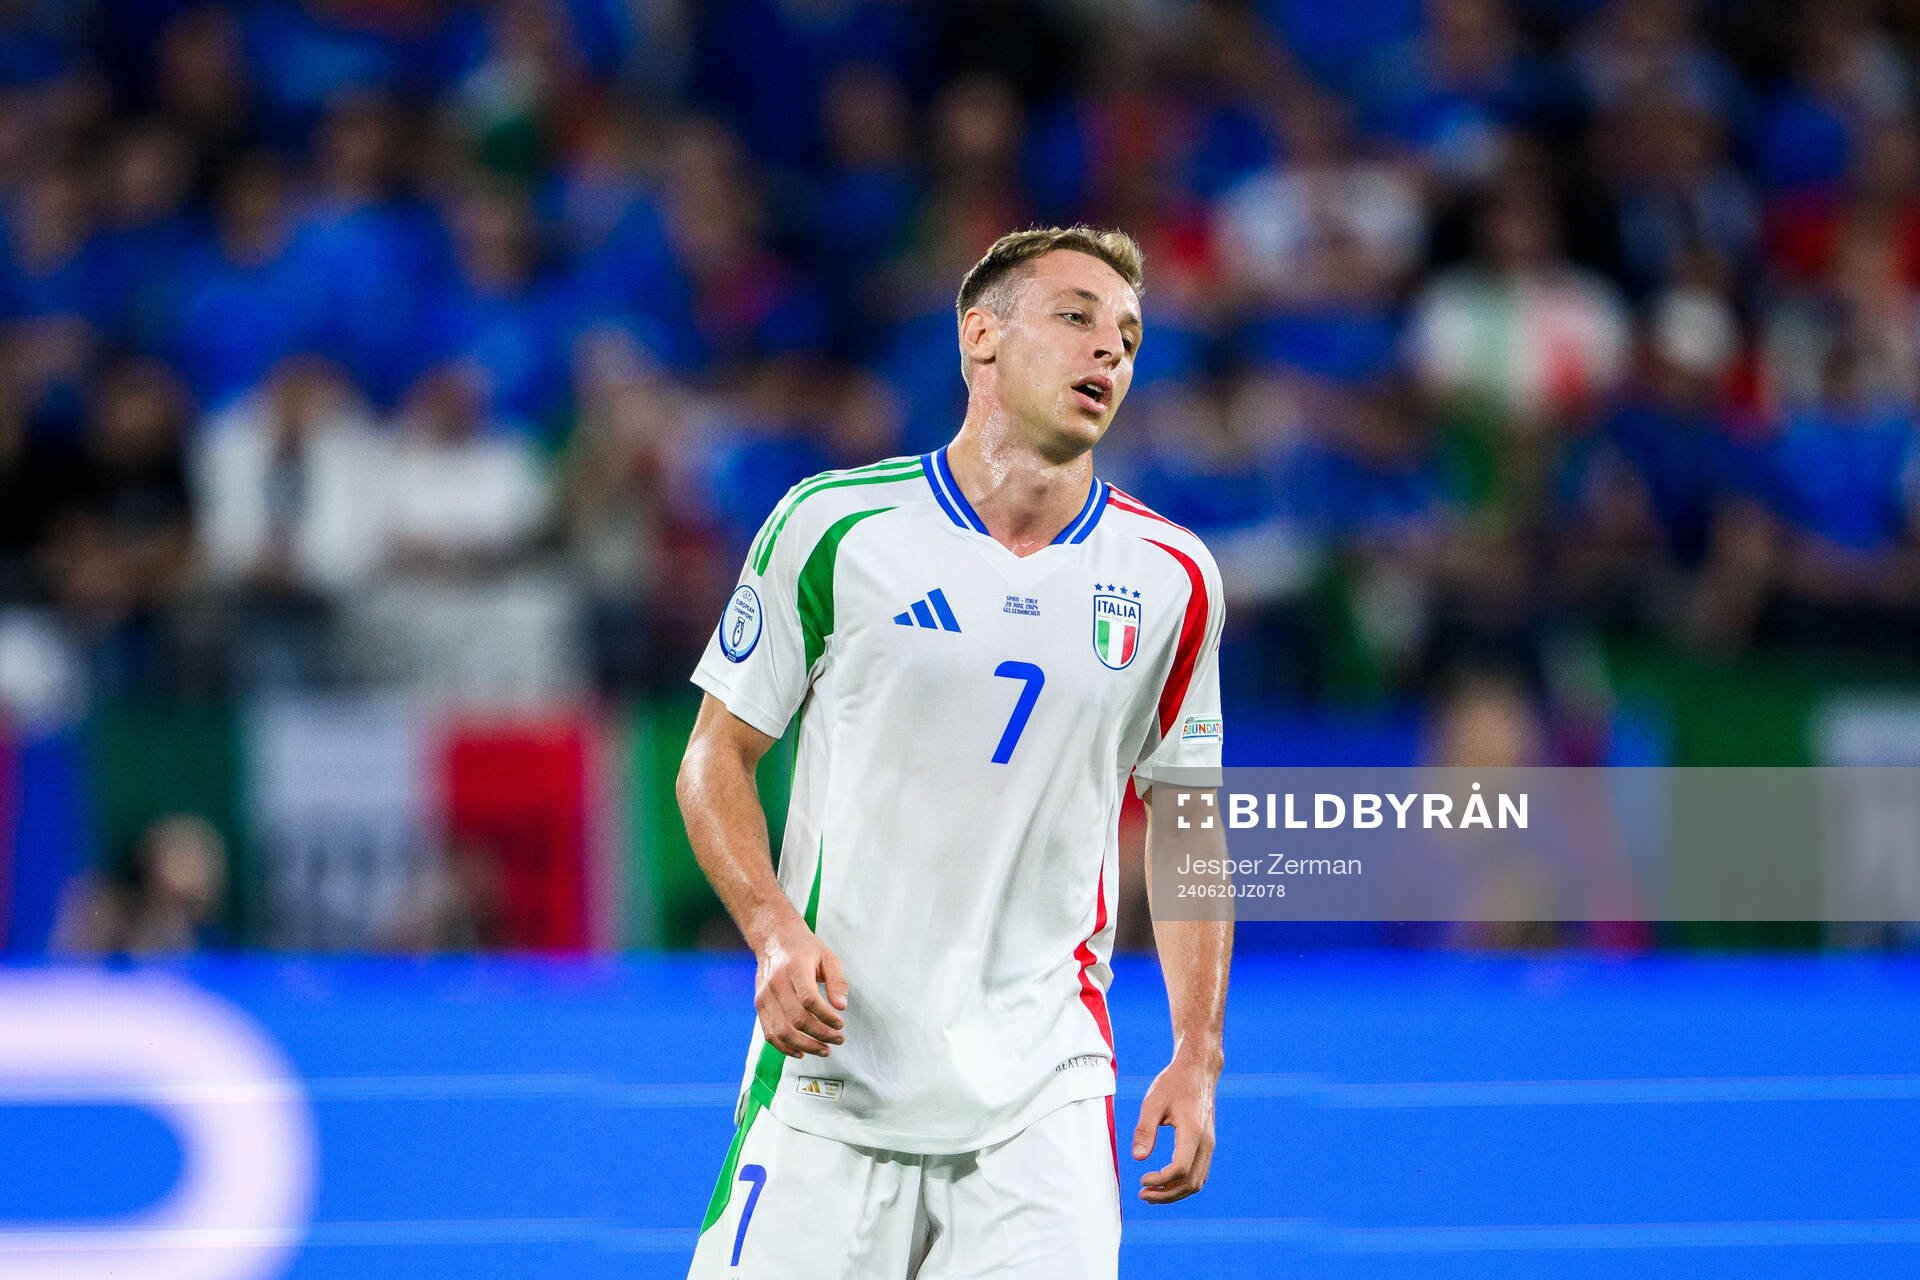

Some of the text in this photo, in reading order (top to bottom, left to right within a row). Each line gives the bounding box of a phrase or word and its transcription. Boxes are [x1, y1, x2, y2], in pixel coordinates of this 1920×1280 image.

[736, 598, 755, 615] EUROPEAN
[1097, 599, 1137, 619] ITALIA
[991, 660, 1046, 765] 7
[730, 1164, 768, 1267] 7
